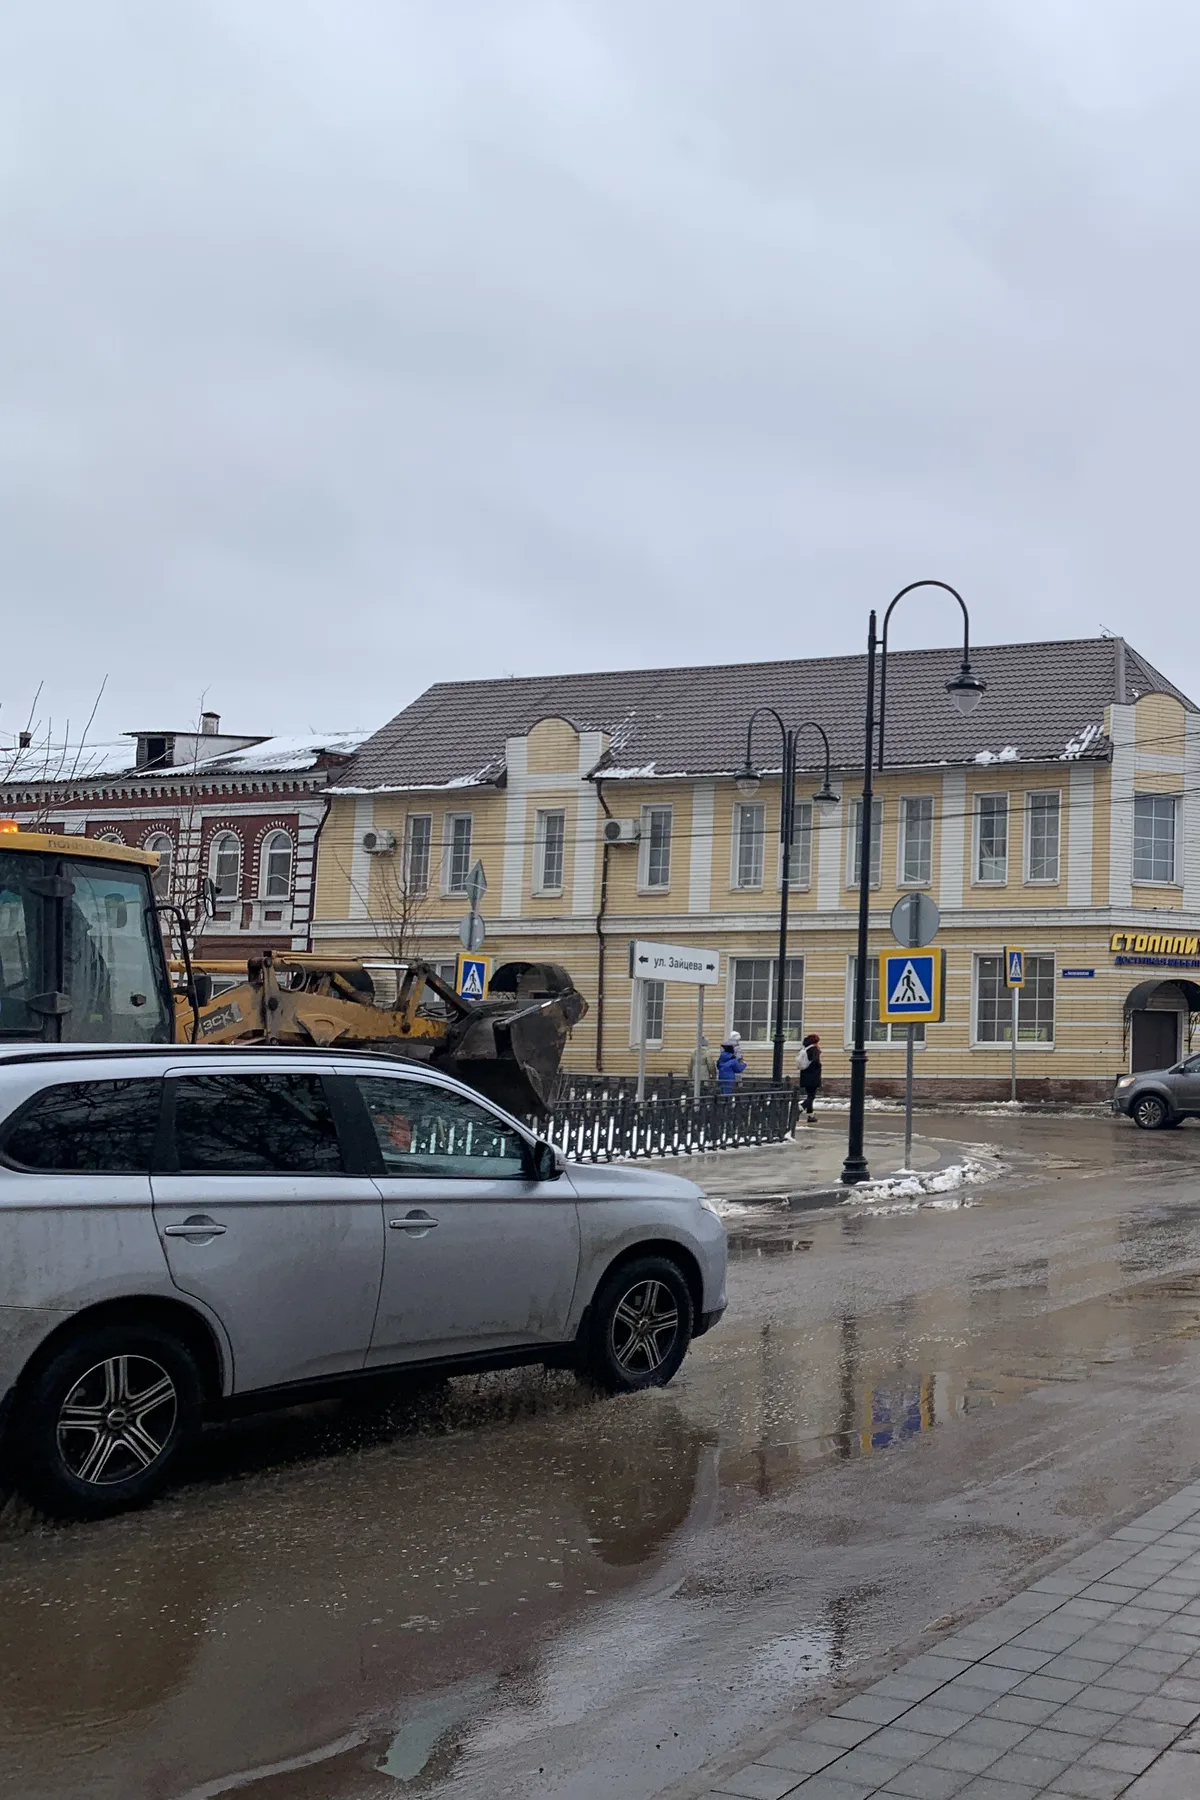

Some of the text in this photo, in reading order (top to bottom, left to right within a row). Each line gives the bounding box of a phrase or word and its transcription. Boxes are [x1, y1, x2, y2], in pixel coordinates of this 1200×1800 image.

[653, 956, 703, 971] ул. Зайцева
[203, 1010, 231, 1031] 3CX
